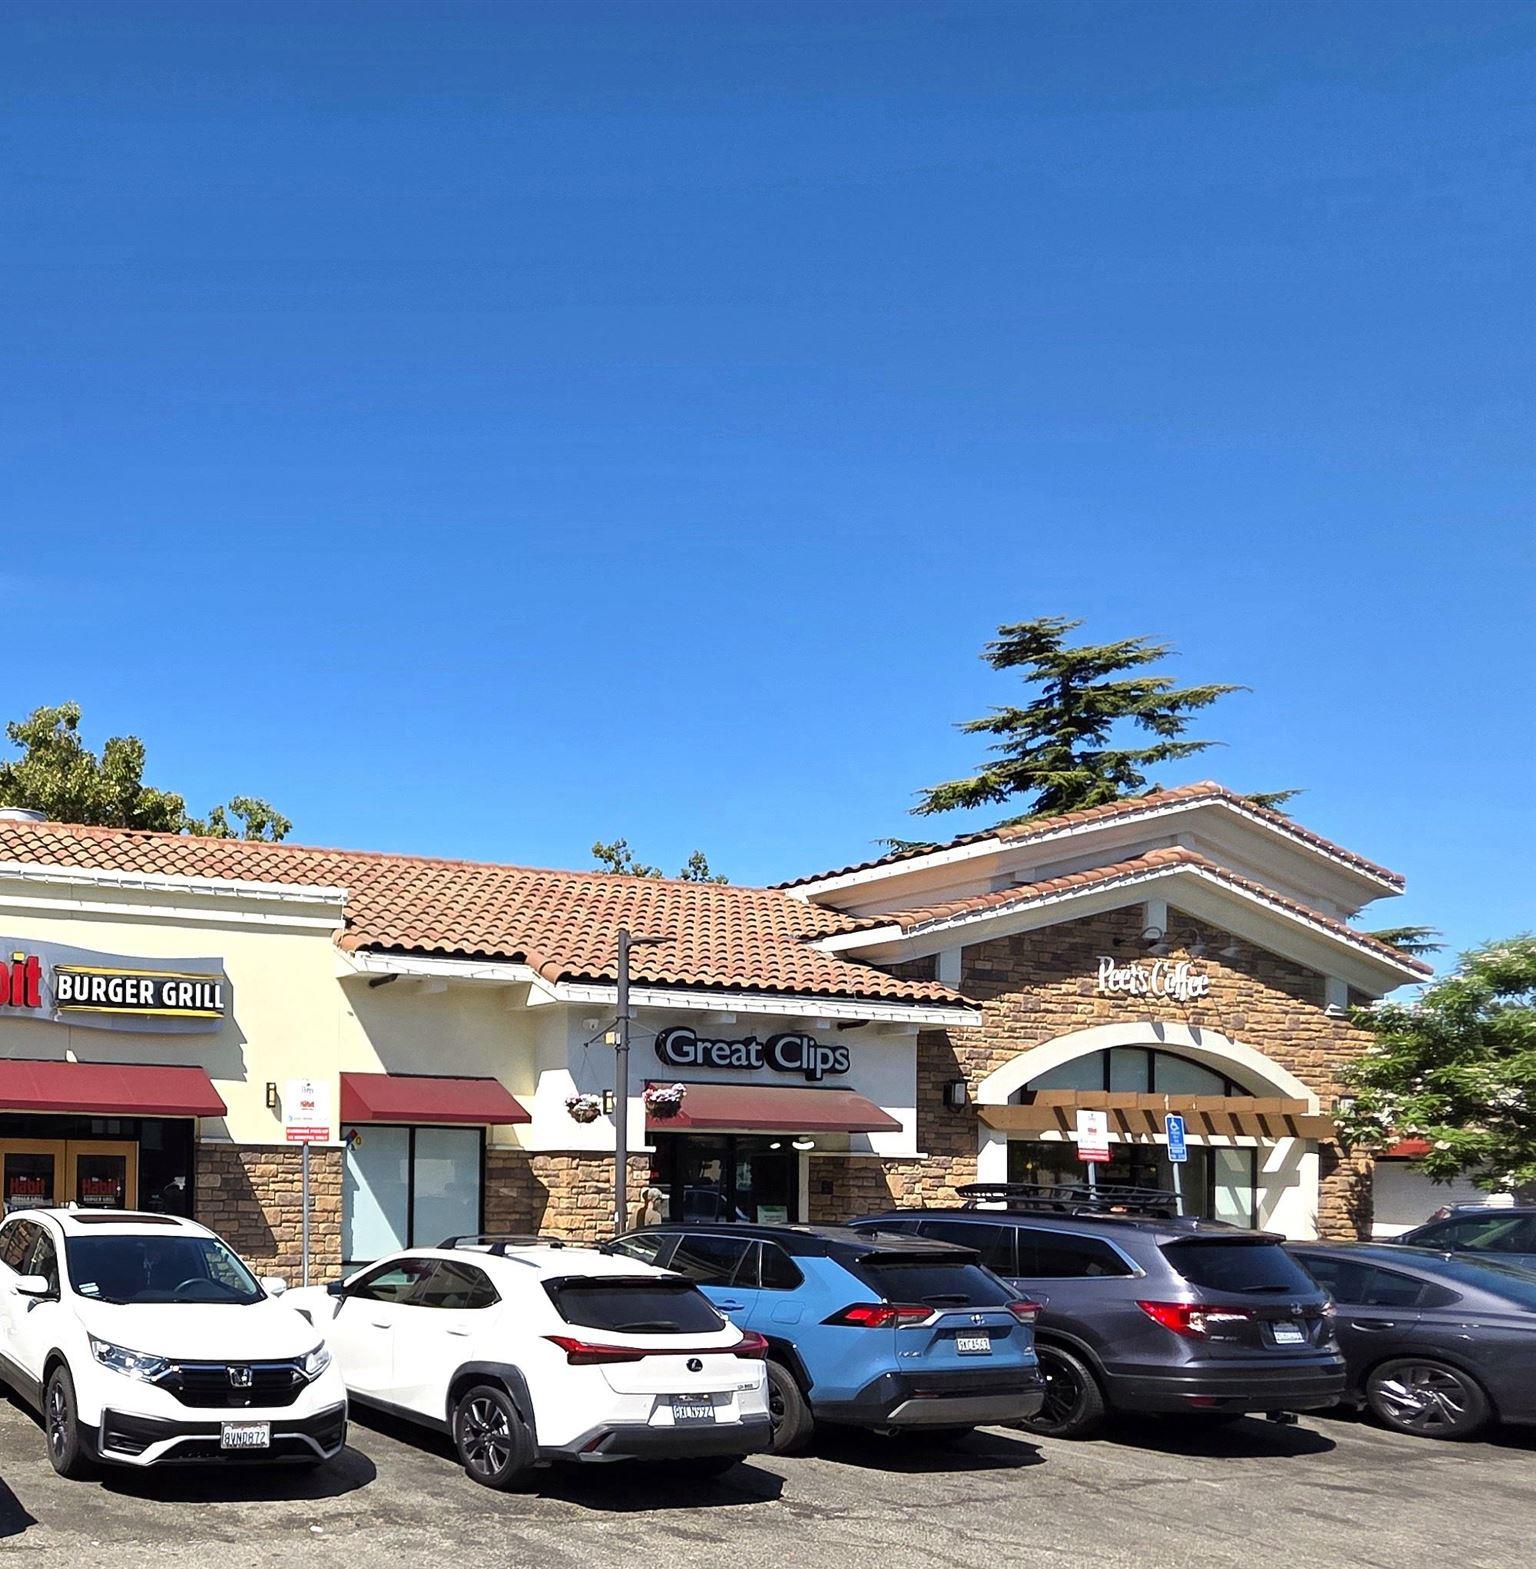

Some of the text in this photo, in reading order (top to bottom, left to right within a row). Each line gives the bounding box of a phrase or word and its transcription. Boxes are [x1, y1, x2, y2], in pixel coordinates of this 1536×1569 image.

[57, 974, 154, 1004] BURGER
[162, 981, 225, 1009] GRILL
[1151, 961, 1210, 1001] Coffee
[665, 1030, 850, 1079] Great Clips
[224, 1431, 266, 1444] 8VND872
